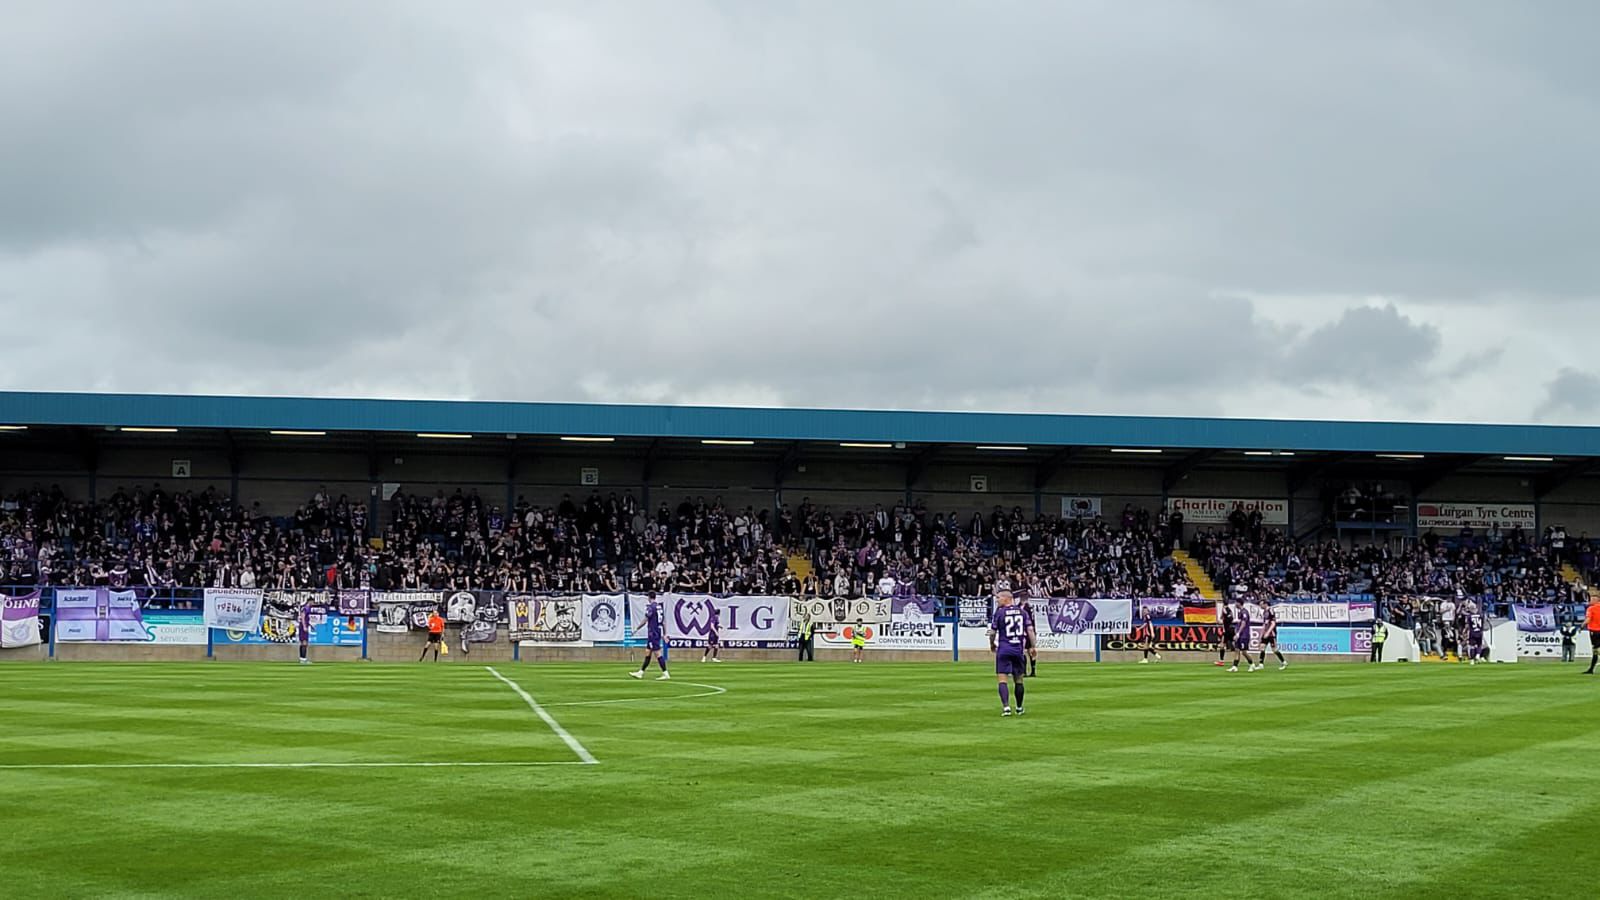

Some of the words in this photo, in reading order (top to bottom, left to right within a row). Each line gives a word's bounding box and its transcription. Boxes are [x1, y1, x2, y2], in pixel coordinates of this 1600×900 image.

[176, 466, 186, 475] A
[975, 481, 983, 490] C
[1173, 500, 1226, 512] Charlie
[1440, 506, 1473, 519] Lurgan
[1476, 507, 1498, 519] Tyre
[1501, 507, 1535, 519] Centre
[1004, 615, 1024, 637] 23
[1056, 621, 1073, 633] AUE
[1471, 617, 1482, 628] 34
[160, 626, 206, 636] counselling
[1525, 634, 1560, 643] dawson
[695, 640, 724, 648] 851
[1302, 643, 1319, 651] 435
[1322, 643, 1338, 651] 594
